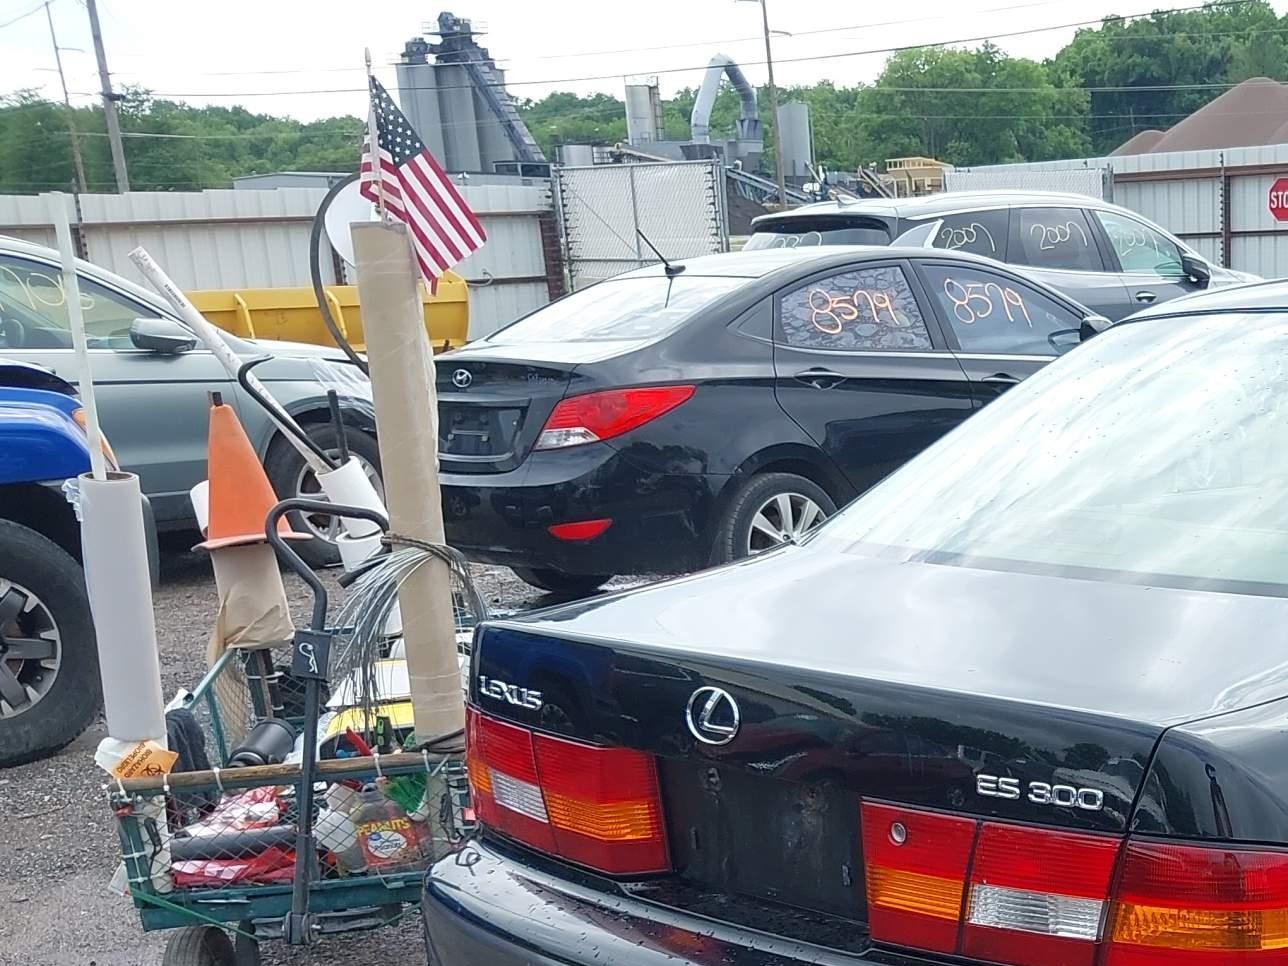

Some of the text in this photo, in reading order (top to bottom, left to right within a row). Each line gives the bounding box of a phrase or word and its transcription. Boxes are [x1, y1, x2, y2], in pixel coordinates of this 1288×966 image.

[809, 288, 899, 334] 8579
[944, 278, 1033, 328] 8579
[479, 675, 543, 711] LEXUS
[976, 774, 1104, 811] ES 300
[356, 815, 412, 837] PEANUTS
